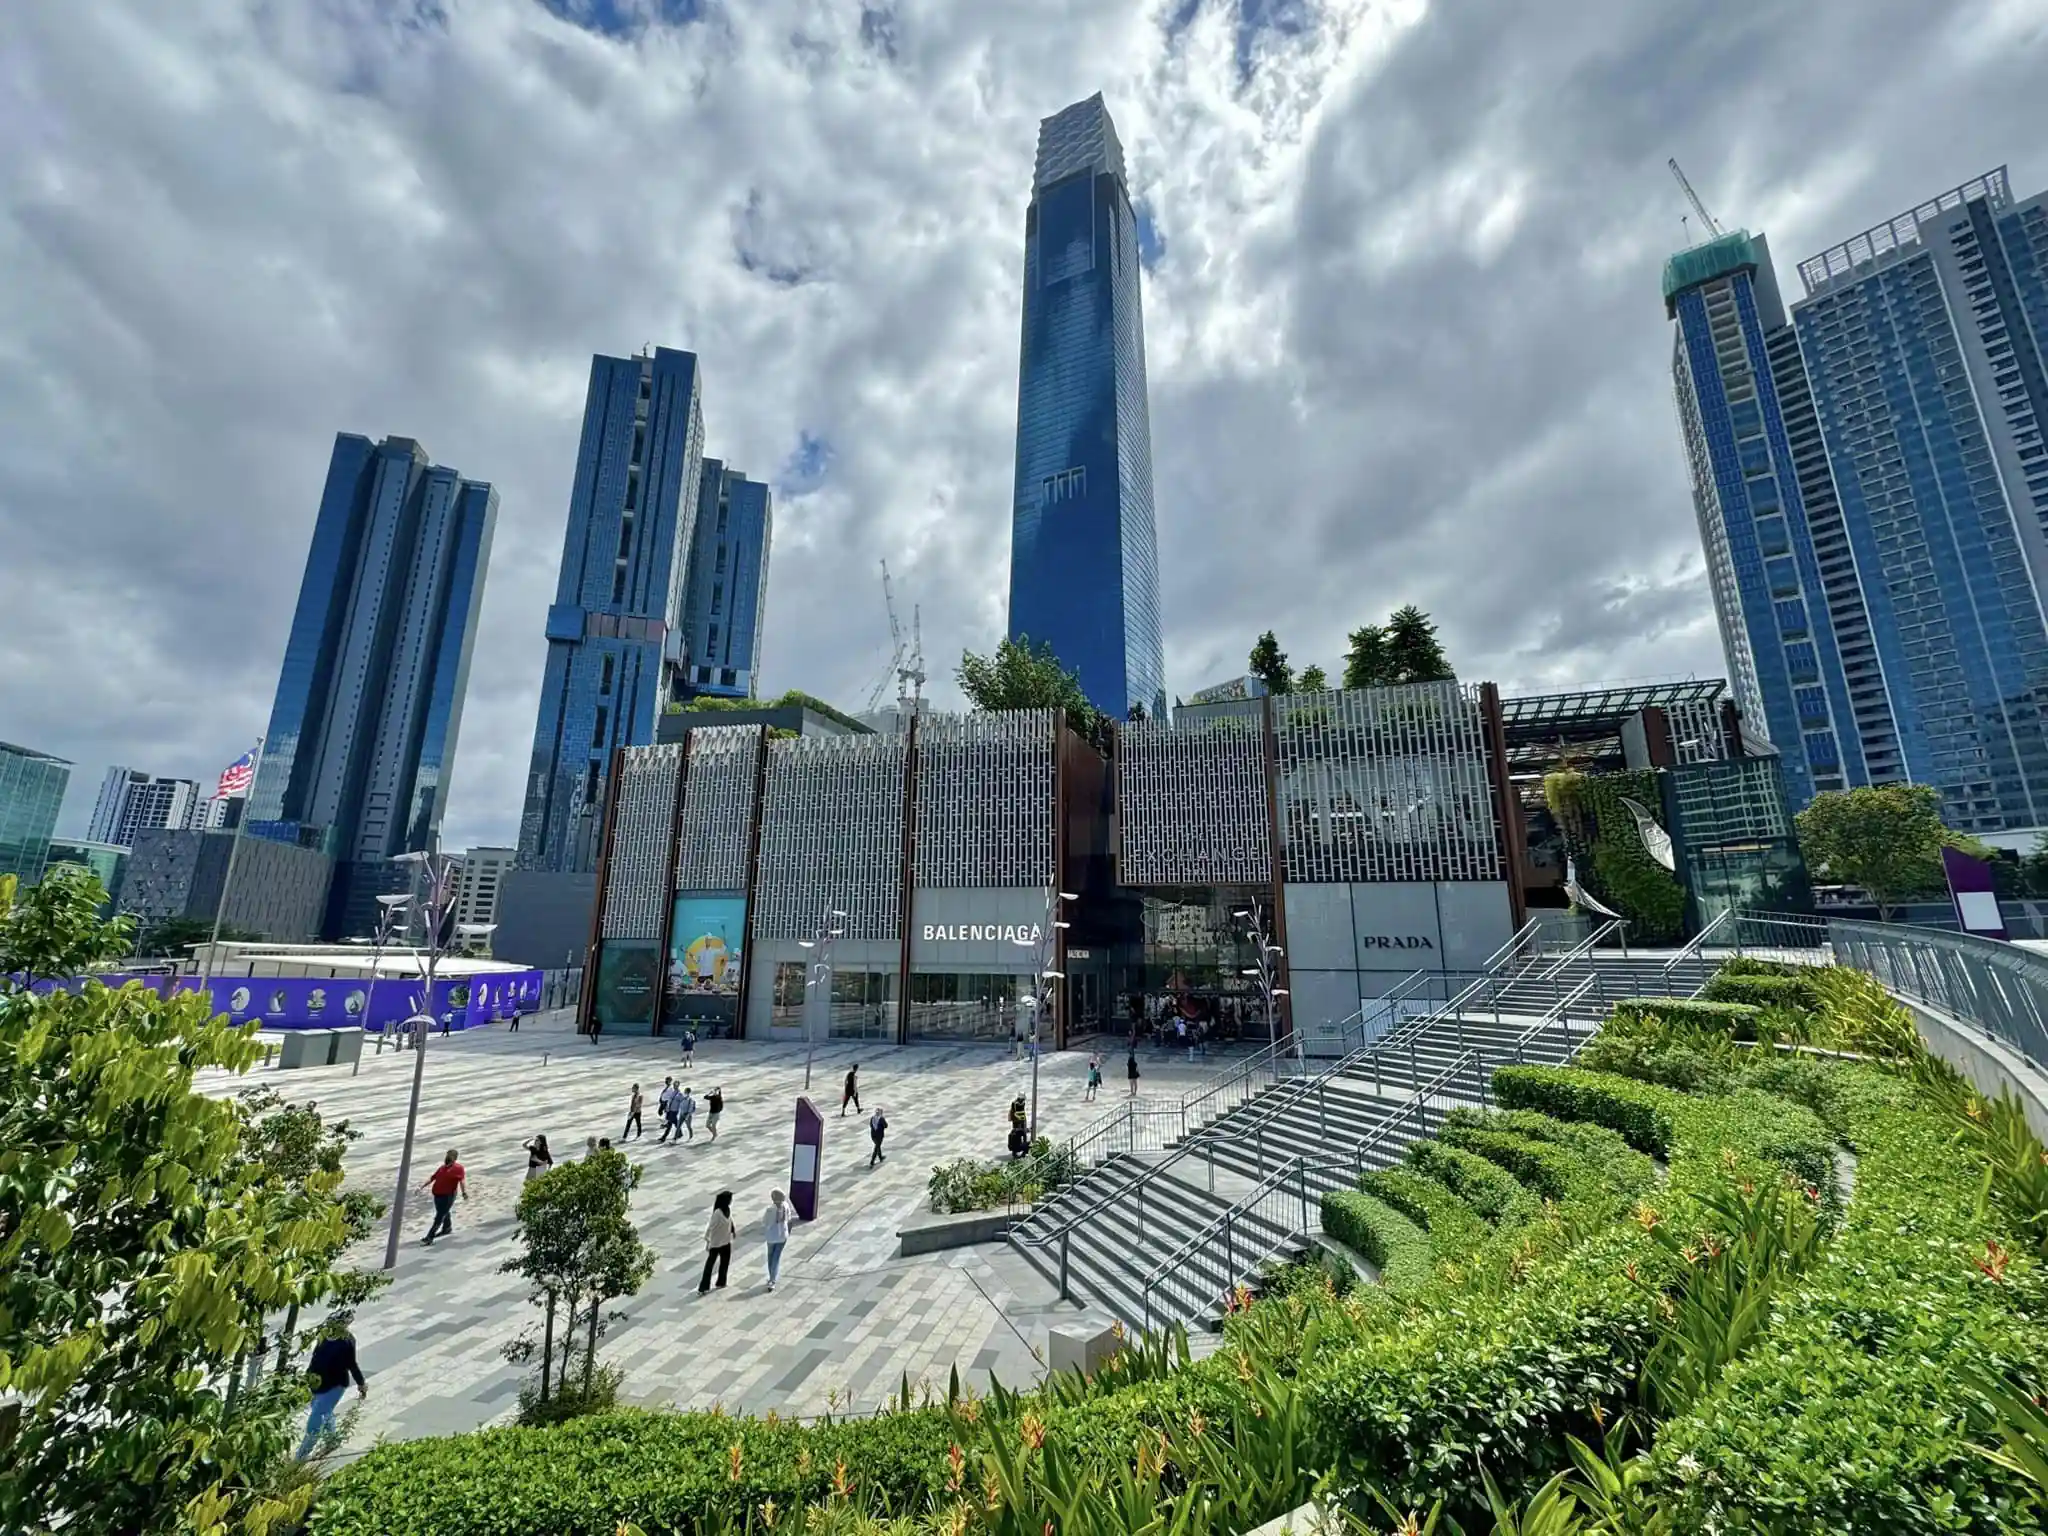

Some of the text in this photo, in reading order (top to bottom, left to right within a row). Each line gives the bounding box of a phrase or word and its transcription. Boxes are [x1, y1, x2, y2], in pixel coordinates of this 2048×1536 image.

[1133, 846, 1260, 862] EXCHANGE
[923, 924, 1043, 941] BALENCIAGA
[1364, 936, 1433, 949] PRADA
